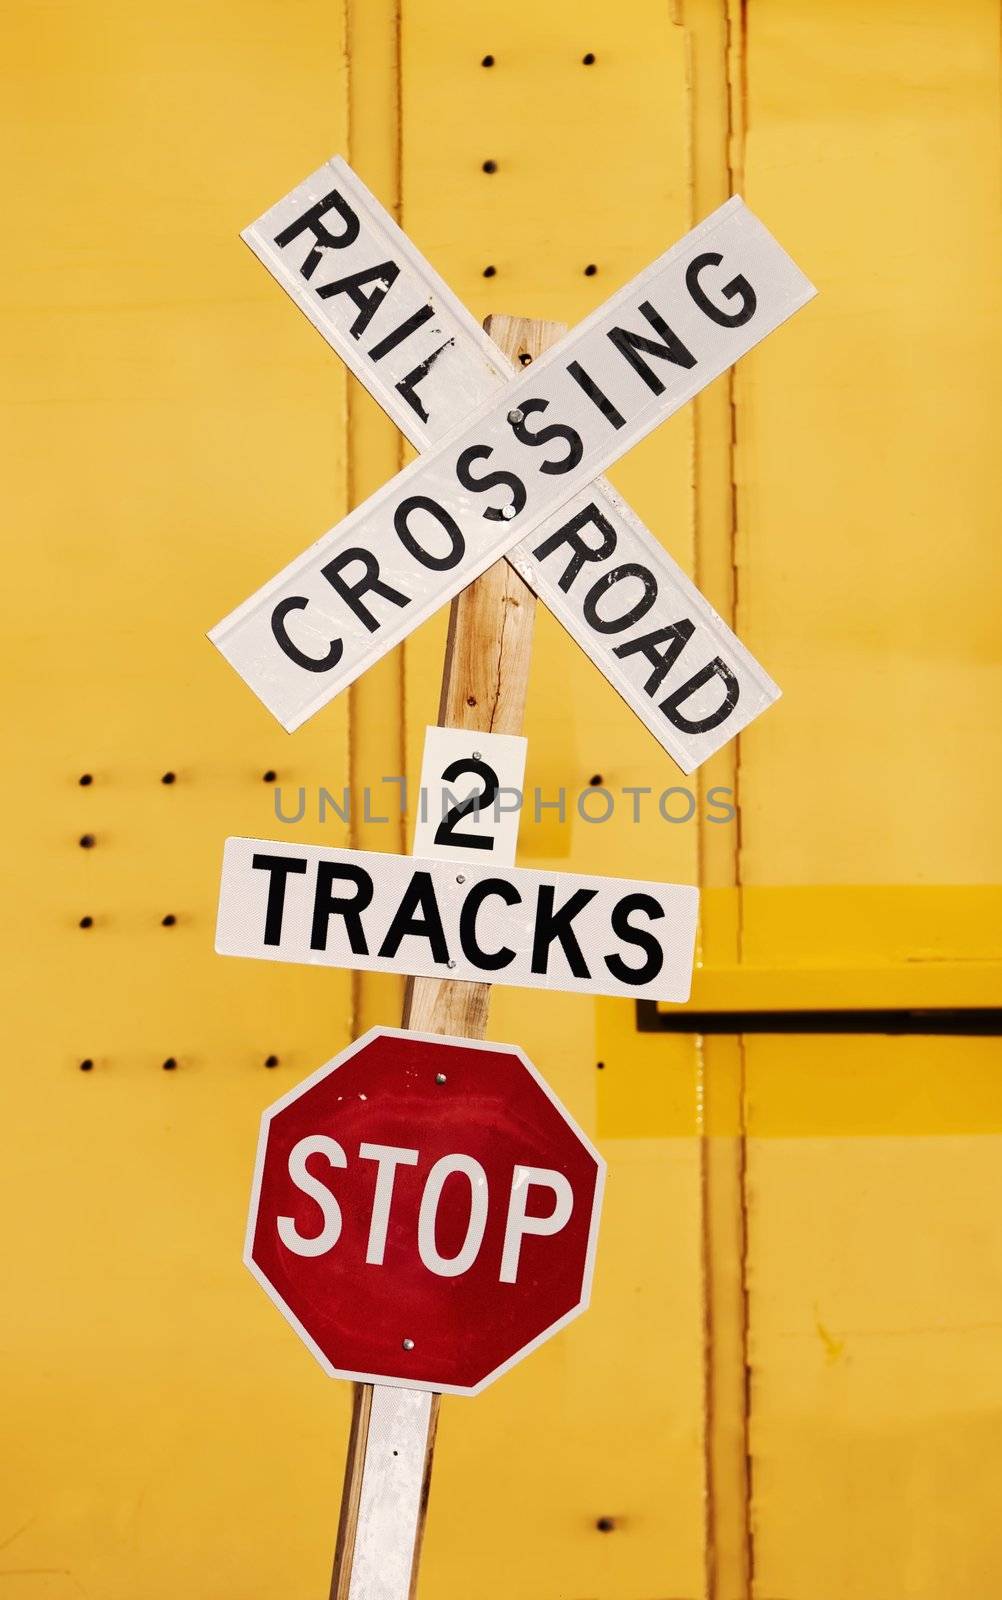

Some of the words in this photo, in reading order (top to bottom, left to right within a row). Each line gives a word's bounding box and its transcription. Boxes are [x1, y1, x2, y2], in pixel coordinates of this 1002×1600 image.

[270, 252, 758, 673] CROSSING
[273, 189, 456, 424] RAIL
[532, 502, 740, 735] ROAD
[434, 758, 500, 851] 2
[251, 854, 666, 986] TRACKS
[276, 1135, 575, 1284] STOP
